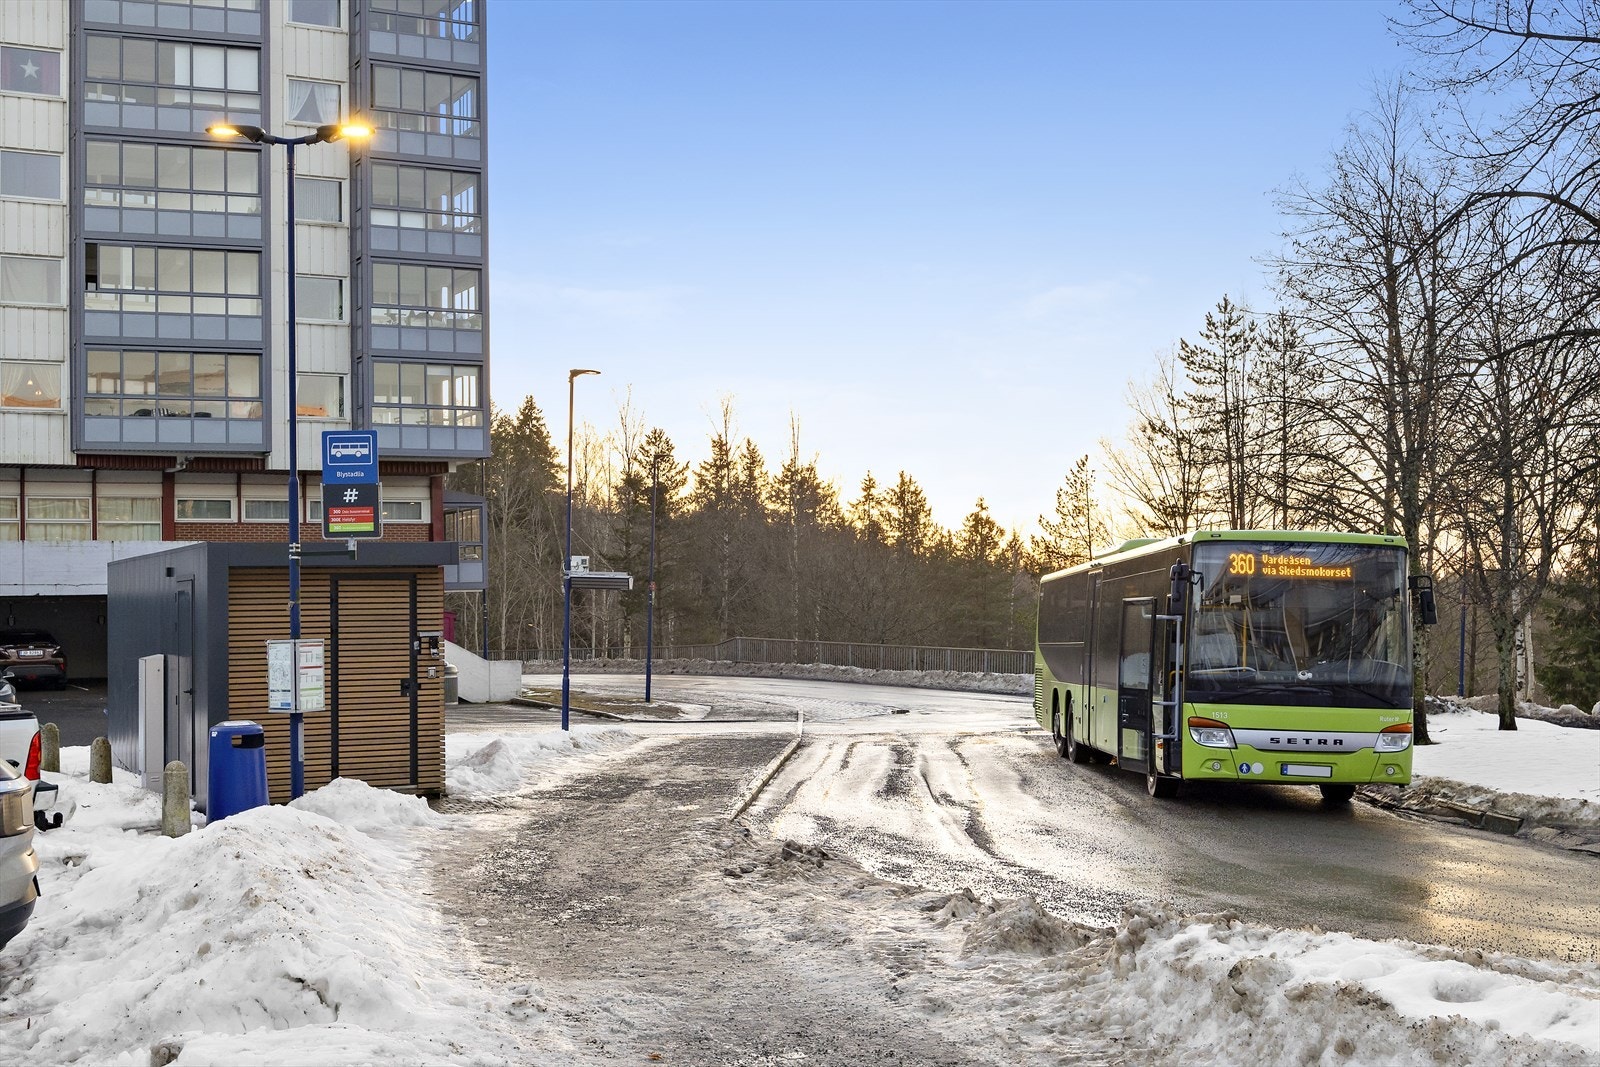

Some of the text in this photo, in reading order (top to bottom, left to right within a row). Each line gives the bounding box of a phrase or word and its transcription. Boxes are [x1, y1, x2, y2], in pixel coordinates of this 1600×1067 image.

[1229, 553, 1255, 575] 360
[1262, 554, 1311, 565] Vardeåsen
[1262, 565, 1352, 577] via Skedsmokorset
[1211, 711, 1228, 719] 1513
[1269, 737, 1344, 746] SETRA
